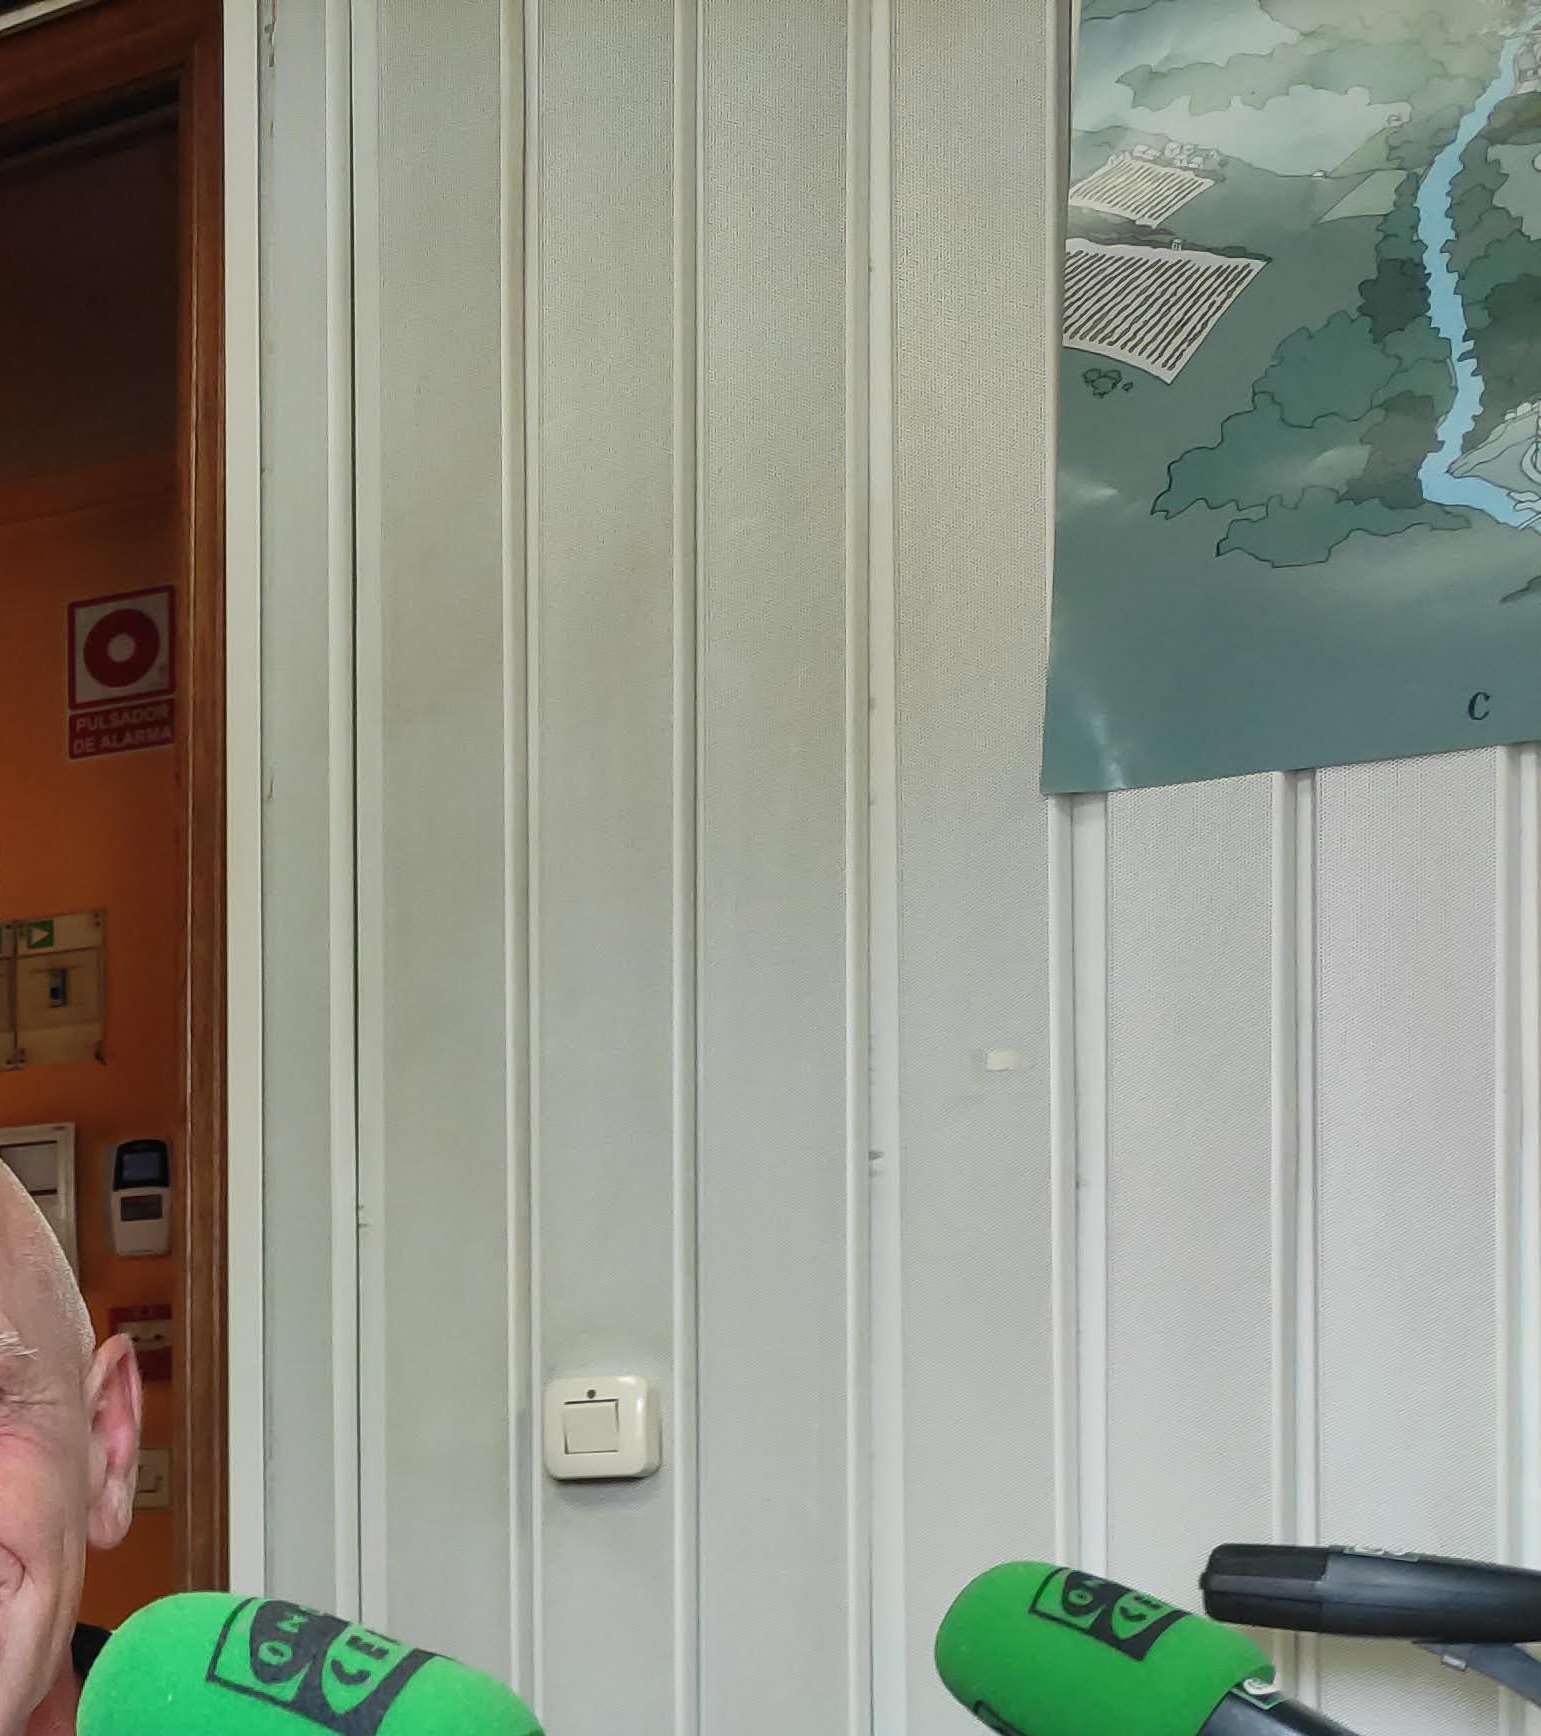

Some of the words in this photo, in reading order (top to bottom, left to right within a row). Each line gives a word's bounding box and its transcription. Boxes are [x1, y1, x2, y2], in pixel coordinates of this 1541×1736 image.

[76, 704, 169, 733] PULSADOR
[73, 736, 97, 755] DE
[99, 724, 173, 750] ALARMA
